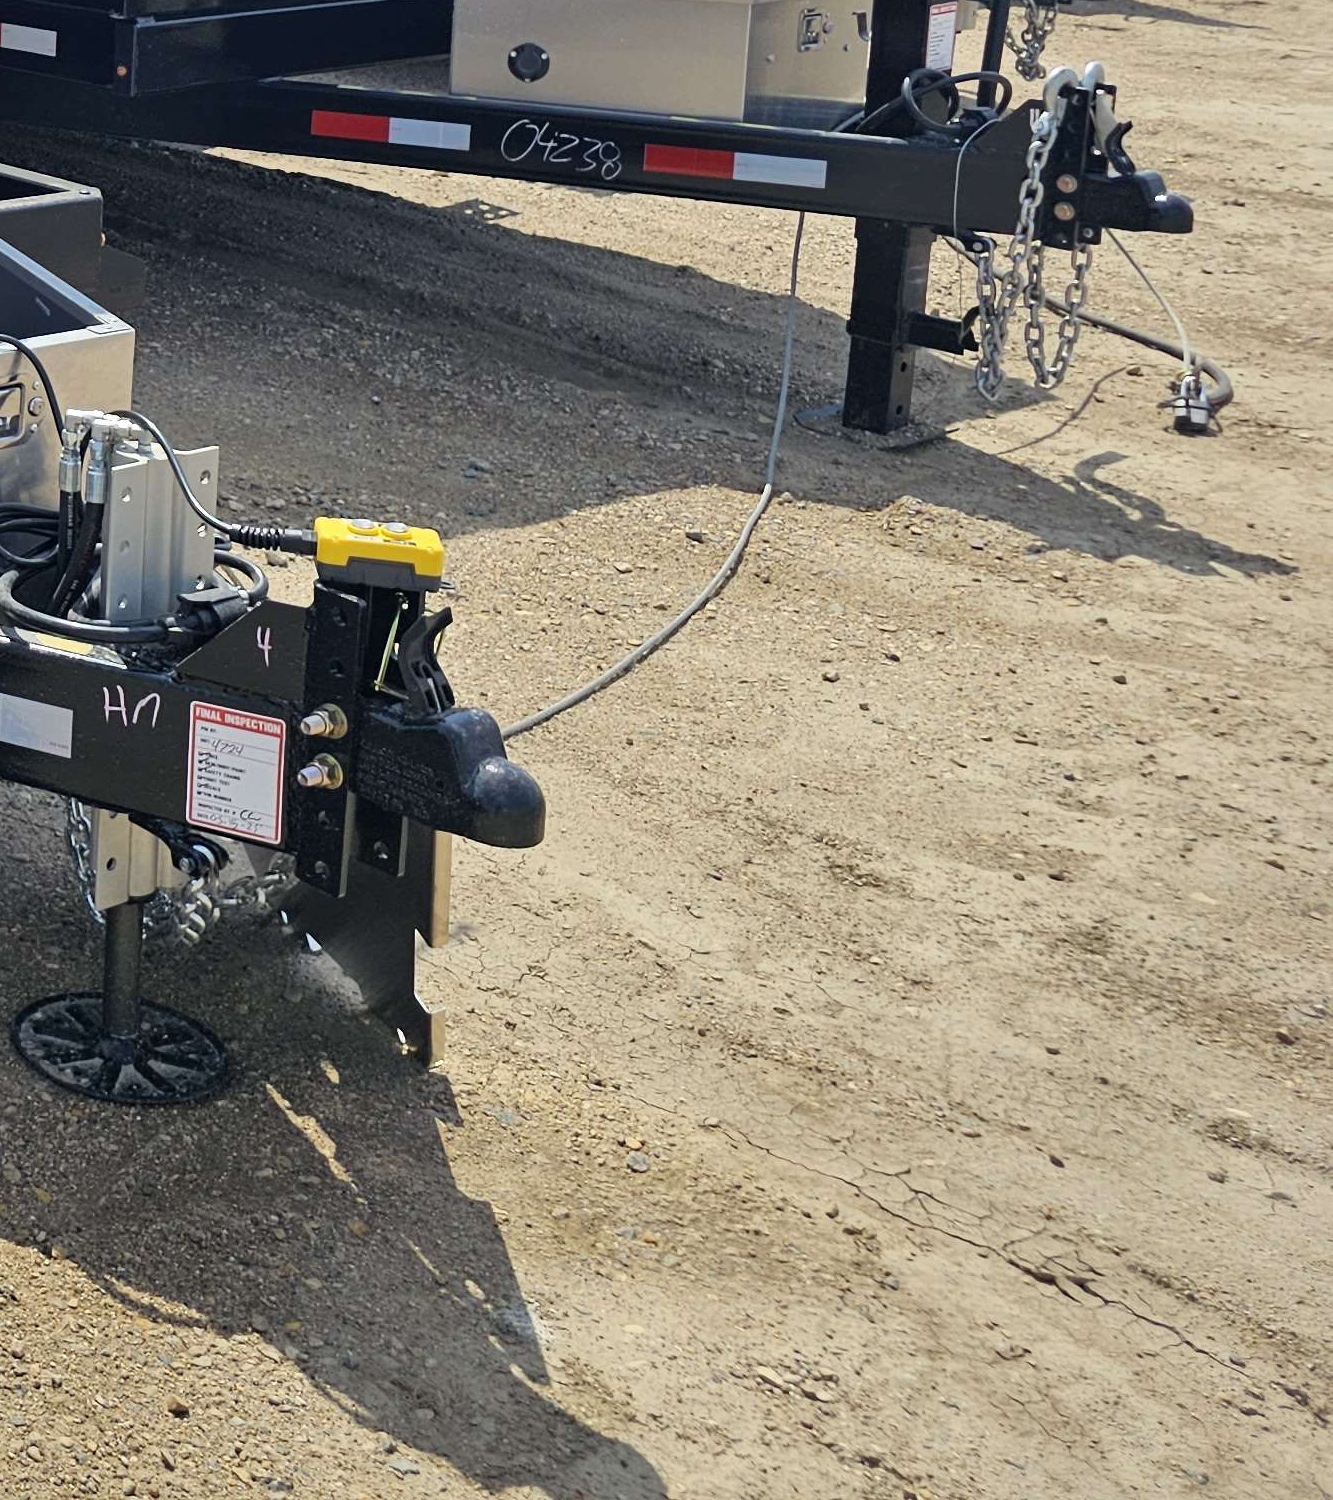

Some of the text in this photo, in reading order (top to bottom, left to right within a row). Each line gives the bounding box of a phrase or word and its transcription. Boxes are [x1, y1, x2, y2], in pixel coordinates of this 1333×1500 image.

[500, 119, 622, 180] 04238
[256, 625, 273, 668] 4
[195, 706, 281, 734] FINAL INSPECTION
